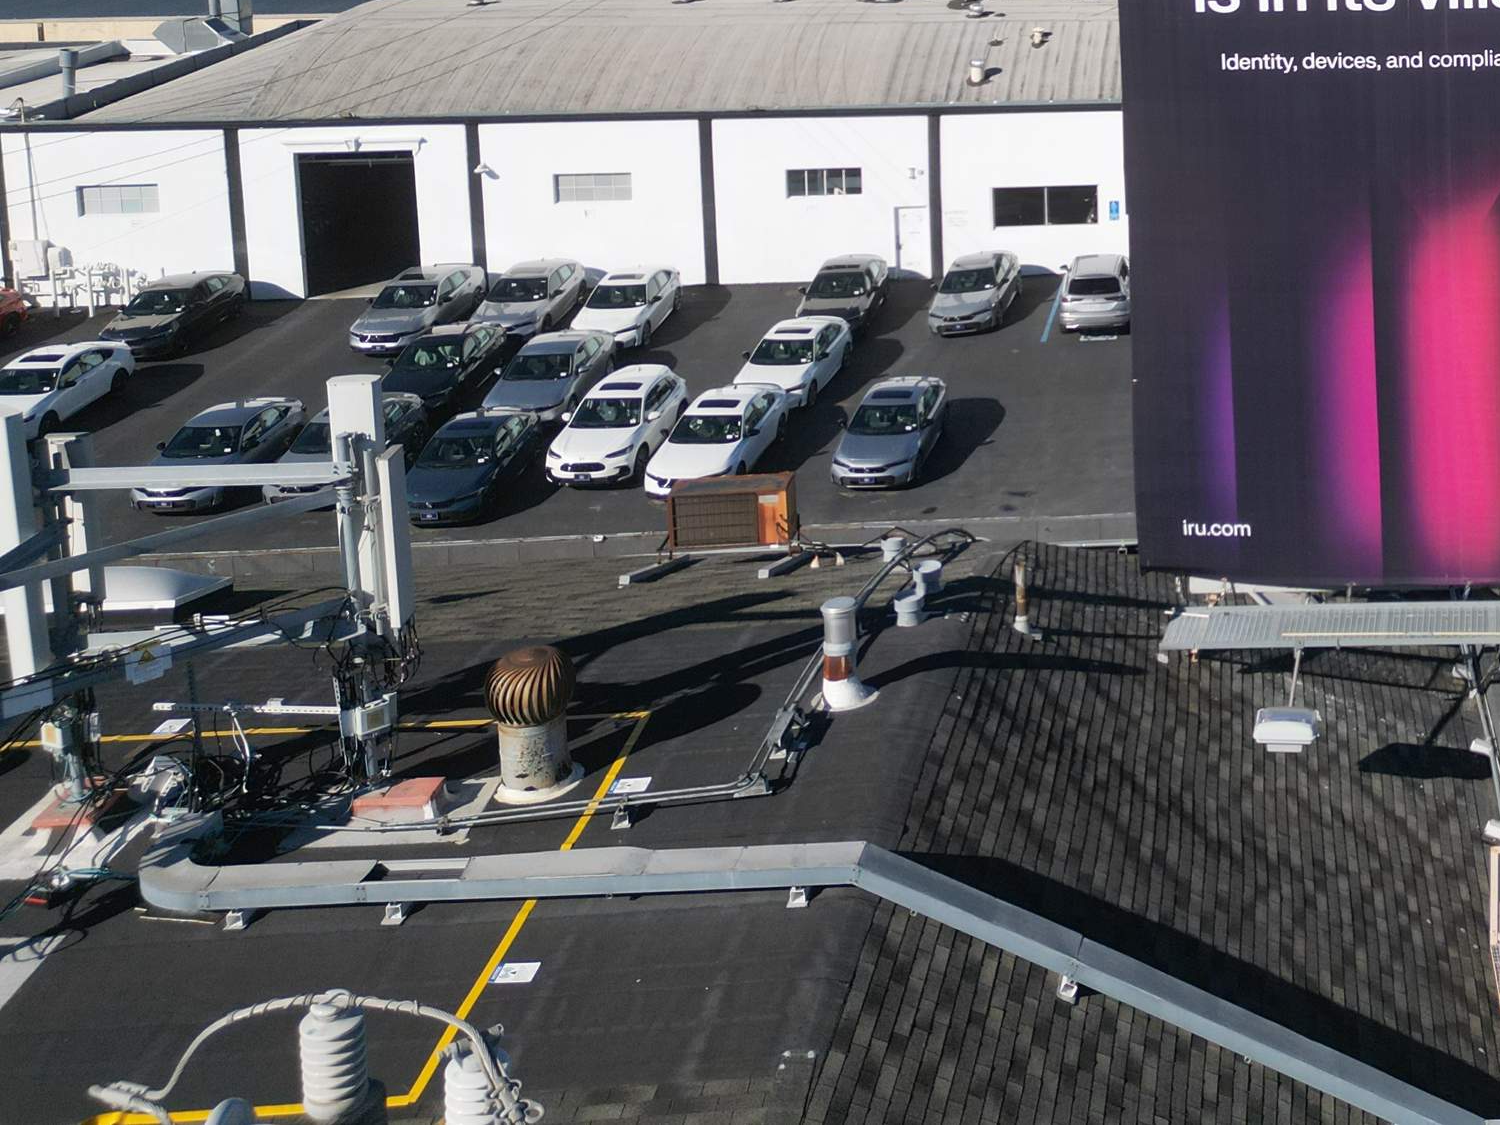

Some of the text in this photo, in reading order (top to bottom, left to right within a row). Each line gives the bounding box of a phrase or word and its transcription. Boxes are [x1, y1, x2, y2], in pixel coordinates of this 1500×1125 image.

[1221, 52, 1298, 74] Identity,
[1302, 51, 1382, 72] devices,
[1386, 50, 1423, 69] and
[1182, 519, 1252, 537] iru.com
